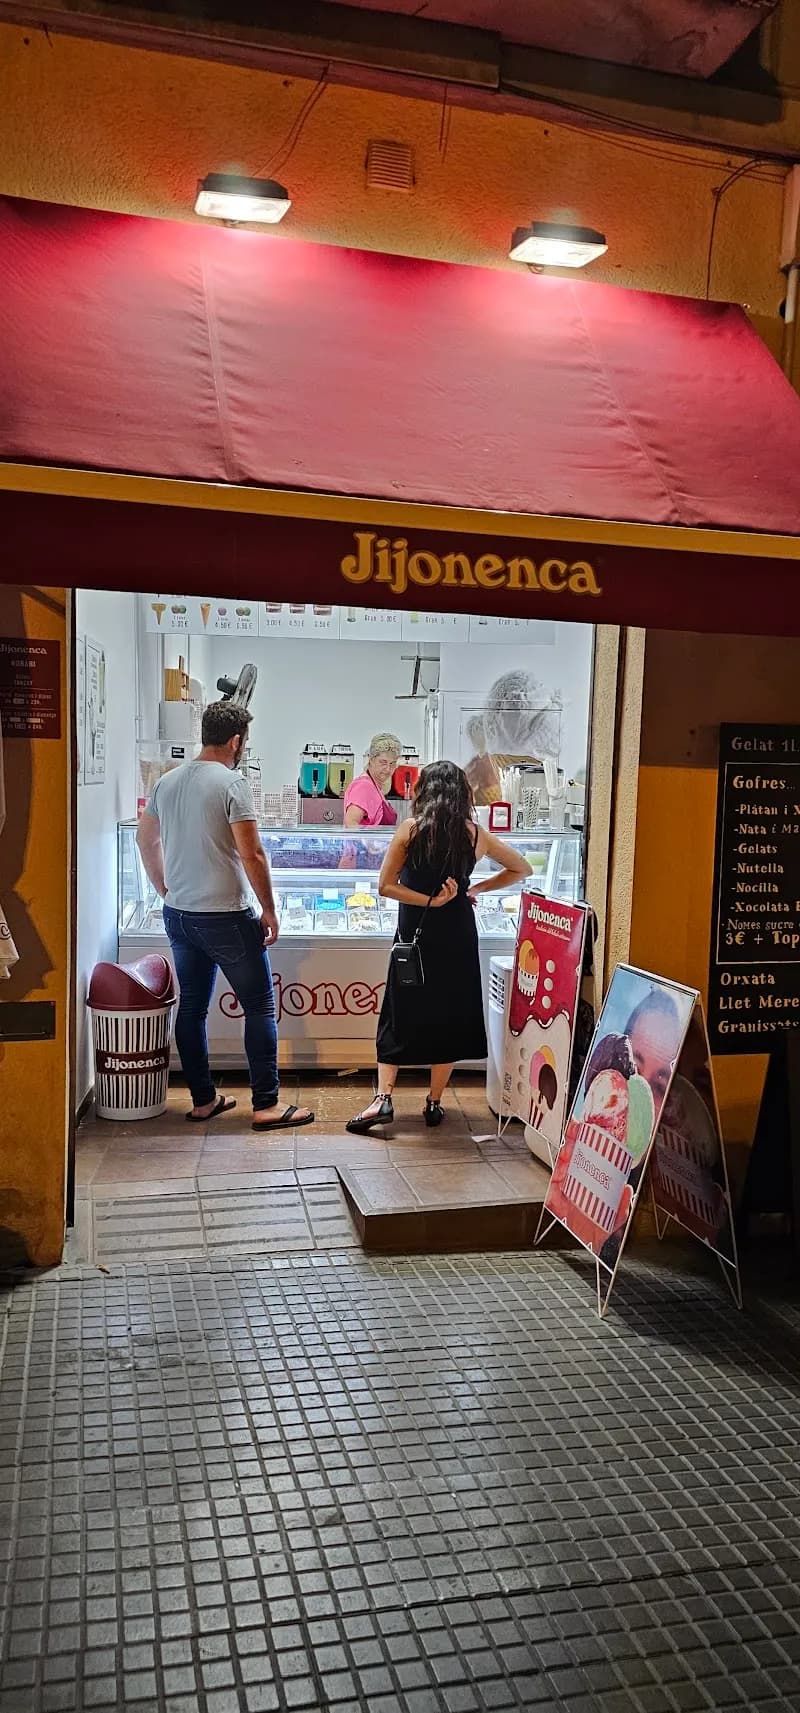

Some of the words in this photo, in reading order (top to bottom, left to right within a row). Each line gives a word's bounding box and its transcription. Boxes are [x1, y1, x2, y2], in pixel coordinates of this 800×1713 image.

[340, 531, 602, 595] Jijonenca
[731, 736, 773, 752] Gelat
[527, 901, 572, 932] Jijonenca
[725, 931, 746, 946] 3€
[771, 930, 800, 949] Top
[720, 972, 776, 986] Orxata
[719, 995, 752, 1010] Llet
[104, 1055, 165, 1072] Jijonenca
